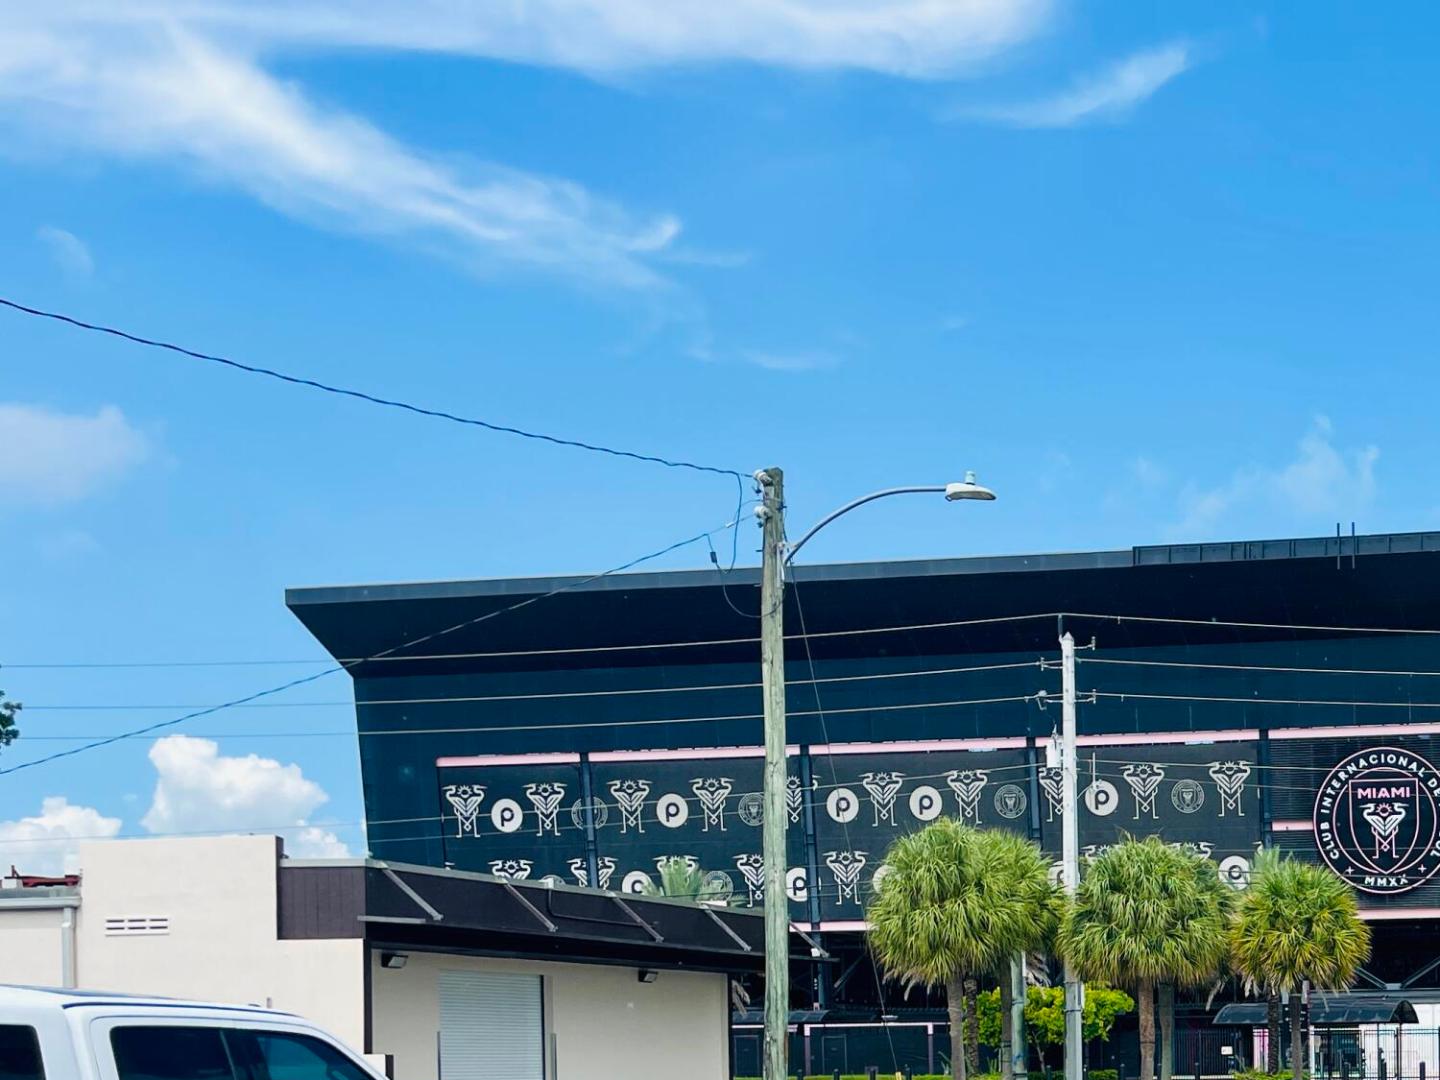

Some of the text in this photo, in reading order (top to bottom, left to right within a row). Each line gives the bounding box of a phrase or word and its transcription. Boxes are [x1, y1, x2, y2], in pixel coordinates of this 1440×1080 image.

[1320, 753, 1425, 814] INTERNACIONAL
[1357, 786, 1411, 800] MIAMI
[1320, 821, 1340, 860] CLUB
[1364, 874, 1409, 887] MMXX
